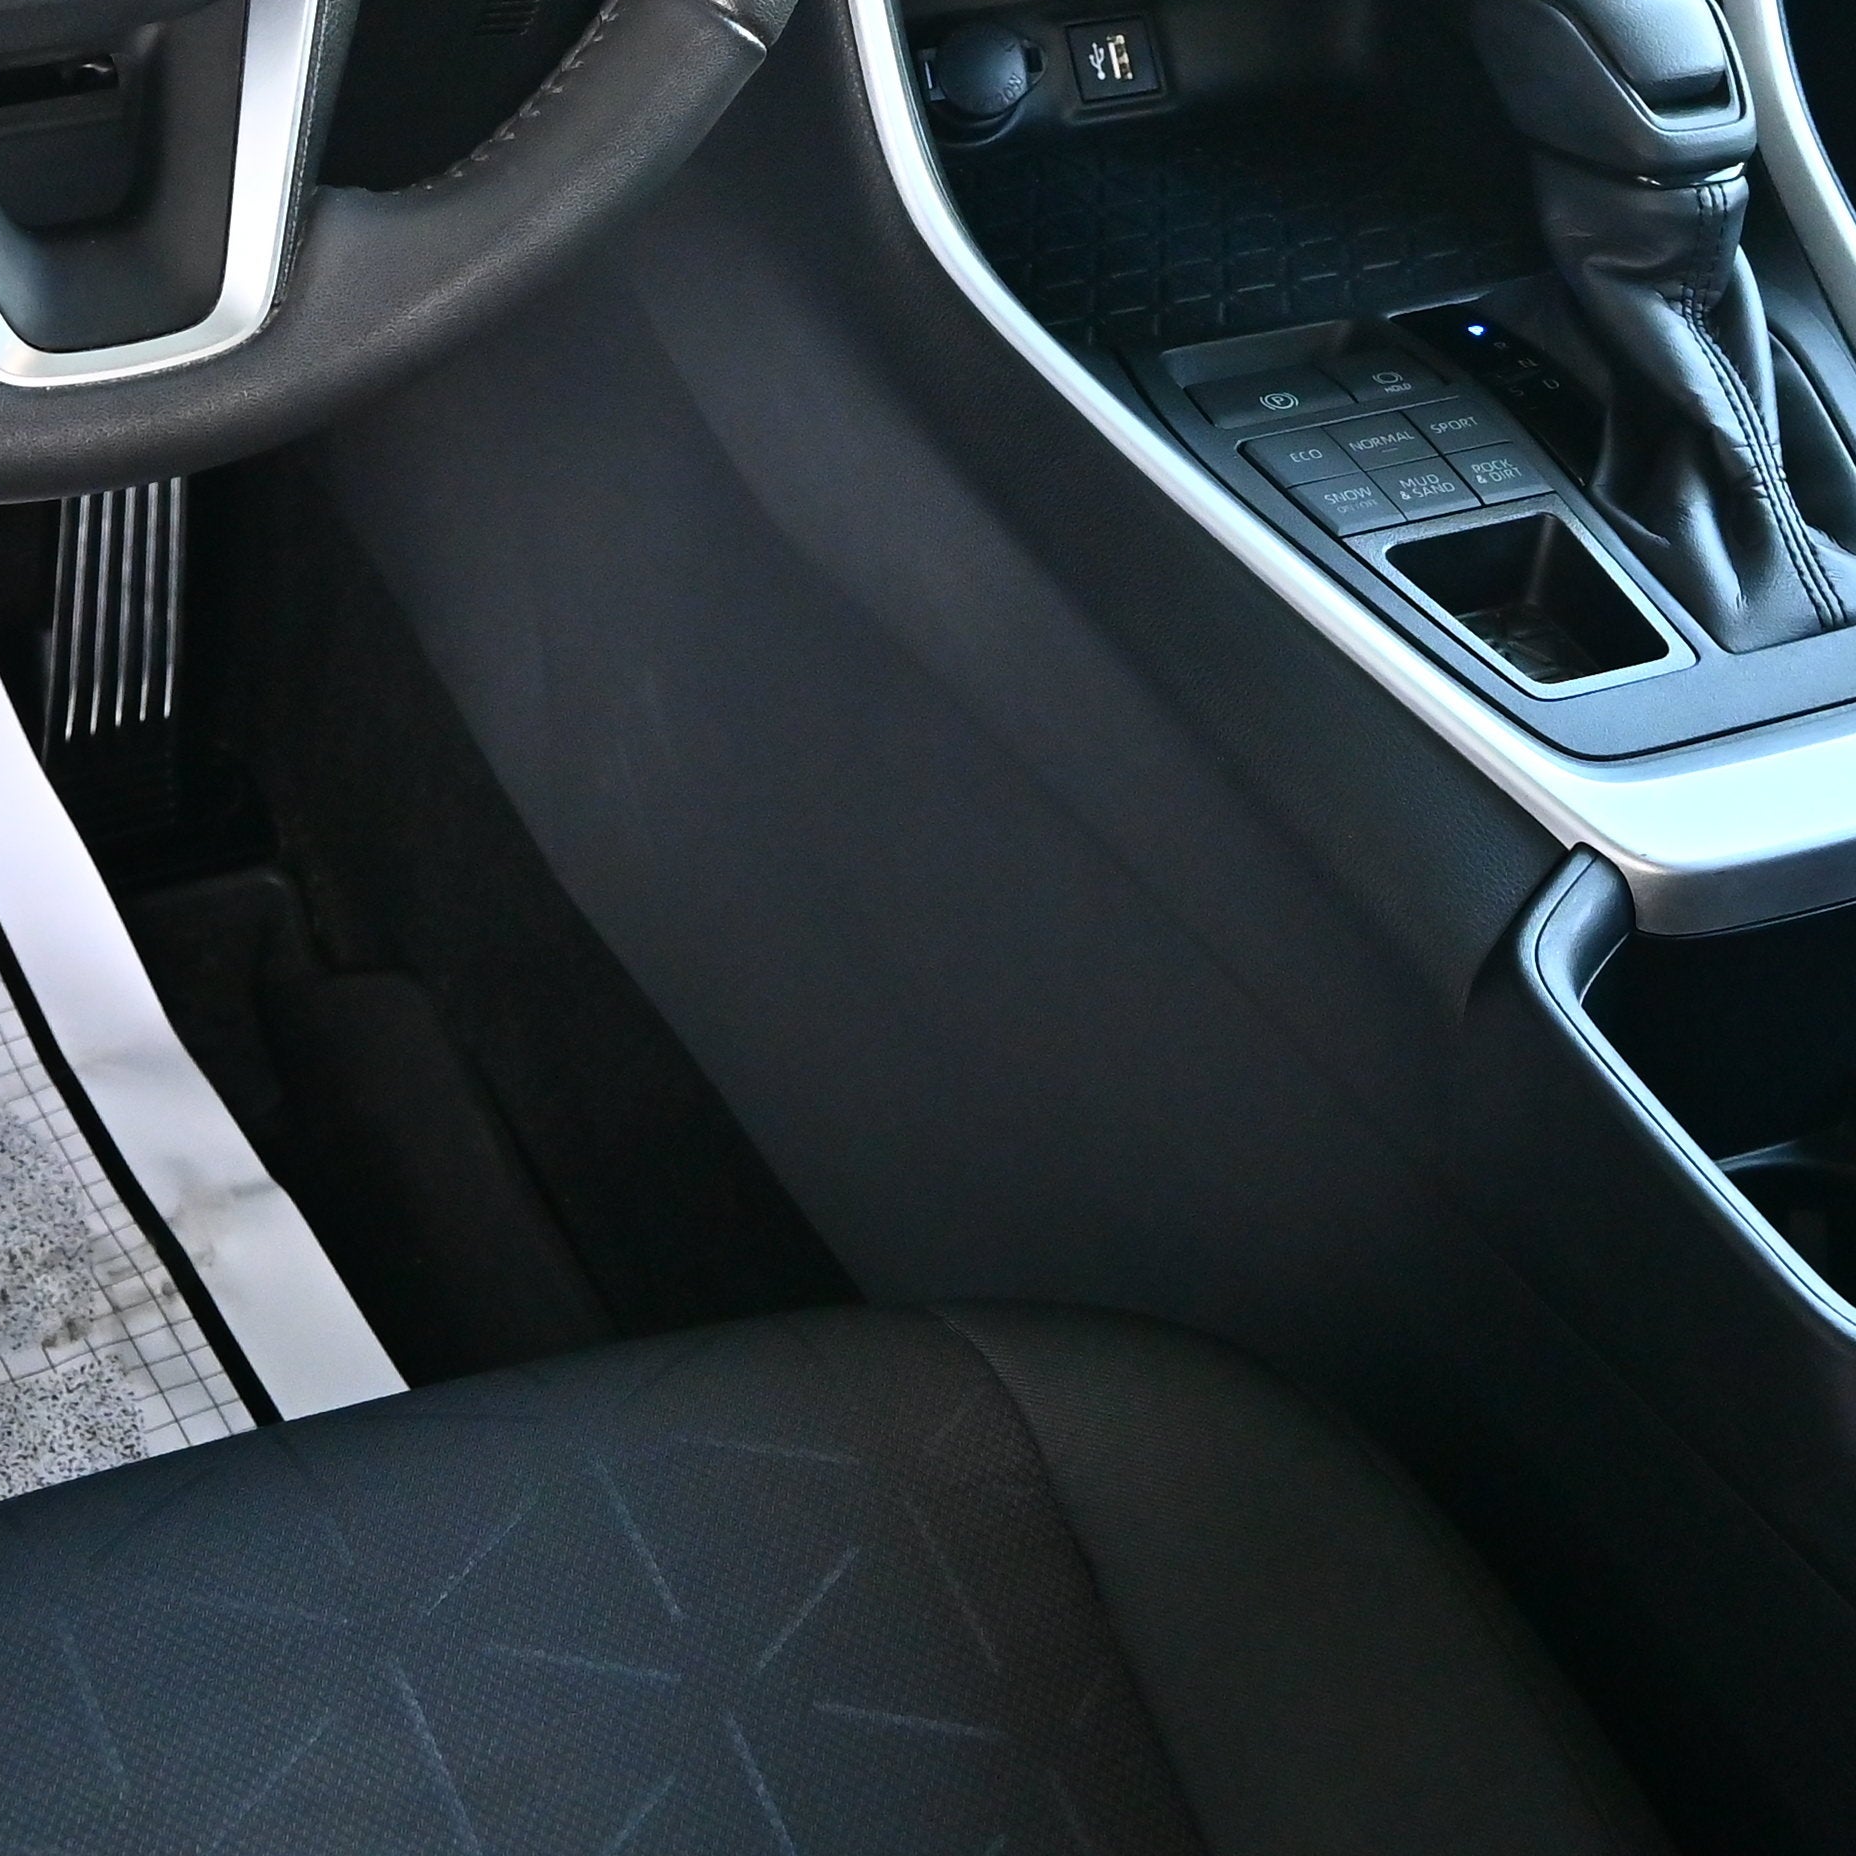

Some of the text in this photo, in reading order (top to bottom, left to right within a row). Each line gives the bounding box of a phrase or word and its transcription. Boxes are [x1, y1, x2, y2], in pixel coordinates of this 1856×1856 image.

[1429, 415, 1479, 435] SPORT
[1348, 430, 1416, 453] NORMAL
[1289, 448, 1324, 464] ECO
[1470, 457, 1513, 474] ROCK
[1398, 473, 1441, 490] MUD
[1476, 466, 1524, 485] & DIRT
[1323, 485, 1373, 506] SNOW
[1399, 481, 1457, 501] & SAND
